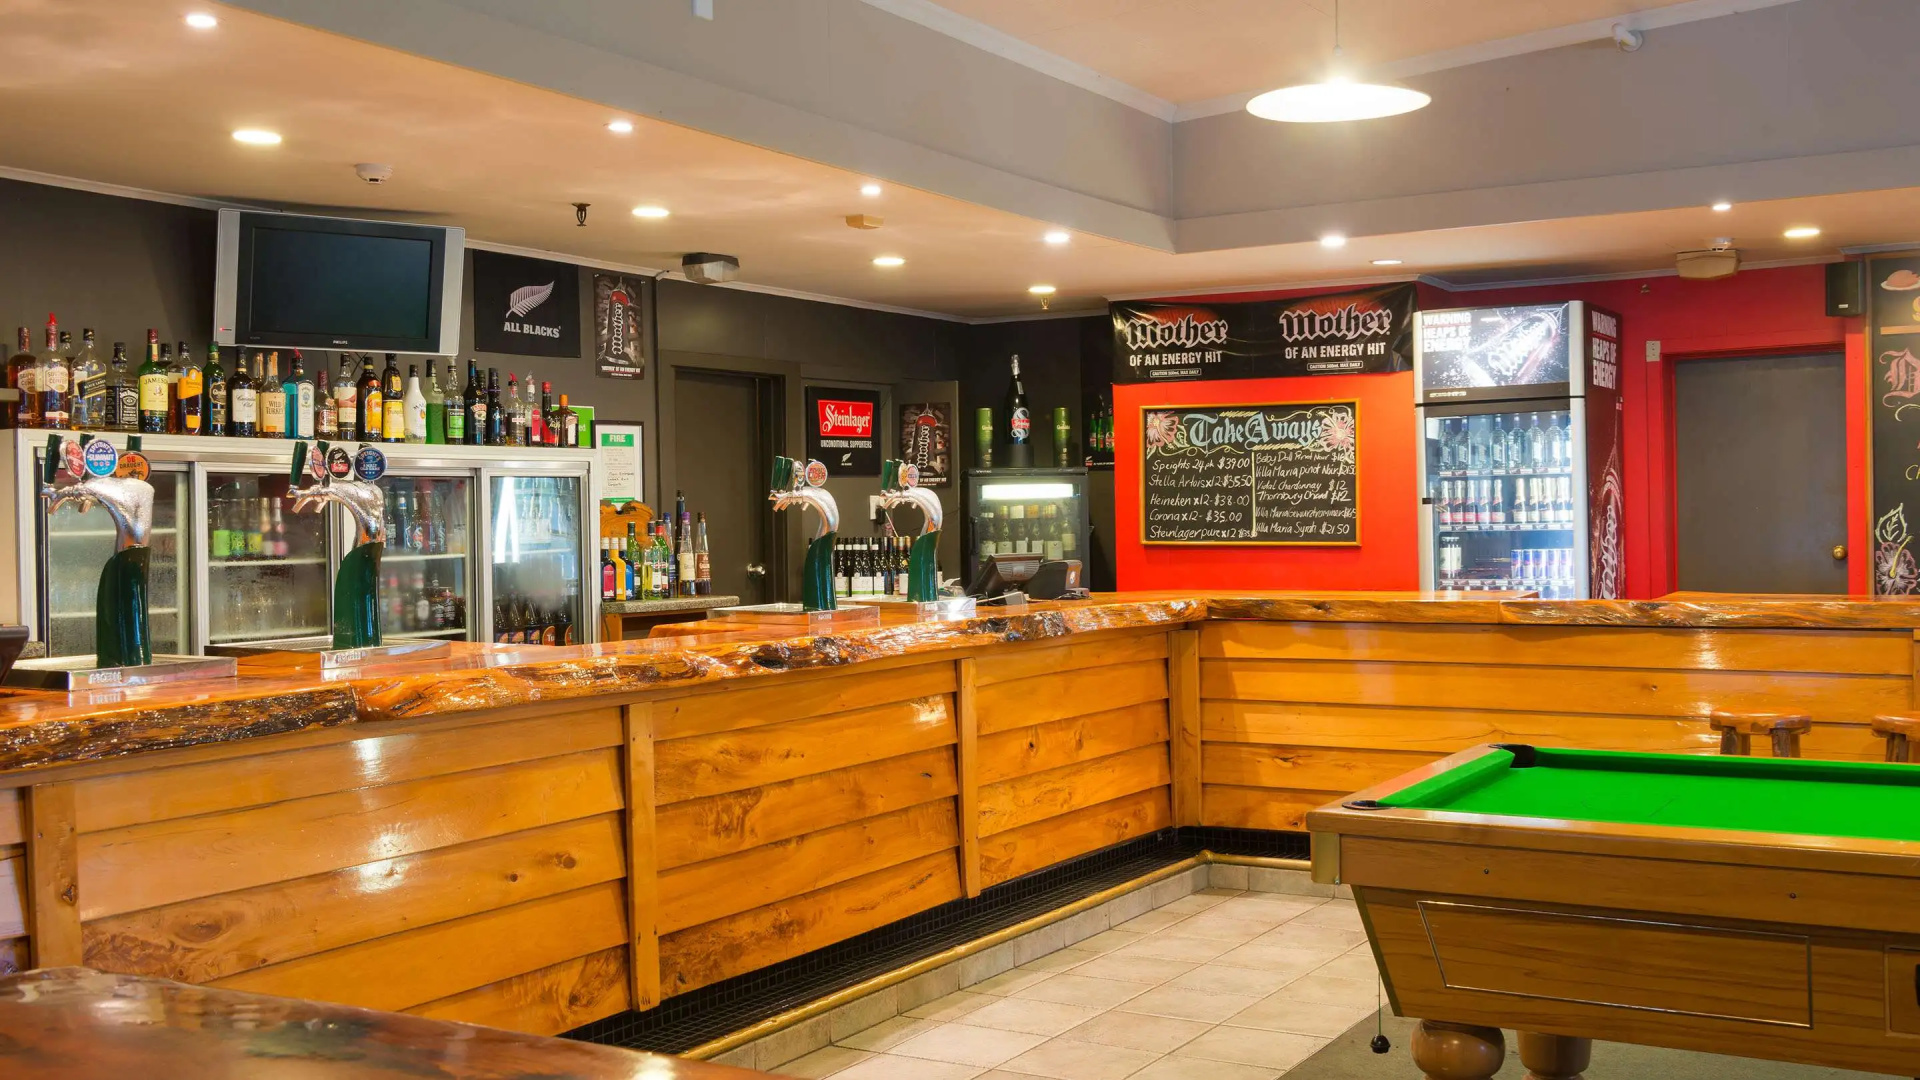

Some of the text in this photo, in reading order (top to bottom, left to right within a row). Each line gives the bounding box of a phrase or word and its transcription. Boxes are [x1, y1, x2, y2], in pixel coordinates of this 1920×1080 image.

[1279, 303, 1393, 343] Mother
[1423, 312, 1471, 325] WARNING
[503, 321, 560, 339] ALL BLACKS
[1125, 313, 1229, 351] Mother
[1423, 325, 1472, 339] HEAPS OF
[1284, 342, 1386, 359] OF AN ENERGY HIT
[1423, 337, 1471, 352] ENERGY
[1129, 350, 1223, 367] OF AN ENERGY HIT
[822, 403, 870, 433] Steinlager
[609, 434, 626, 442] FIRE
[820, 440, 872, 449] UNCONDITIONAL SUPPORTERS
[1152, 459, 1190, 475] Speights
[1272, 464, 1298, 478] Maria
[1148, 474, 1176, 488] Stella
[1150, 493, 1191, 507] Heineken
[1149, 508, 1180, 521] Corona
[1149, 525, 1201, 540] Steinlager
[1269, 522, 1292, 534] Maria
